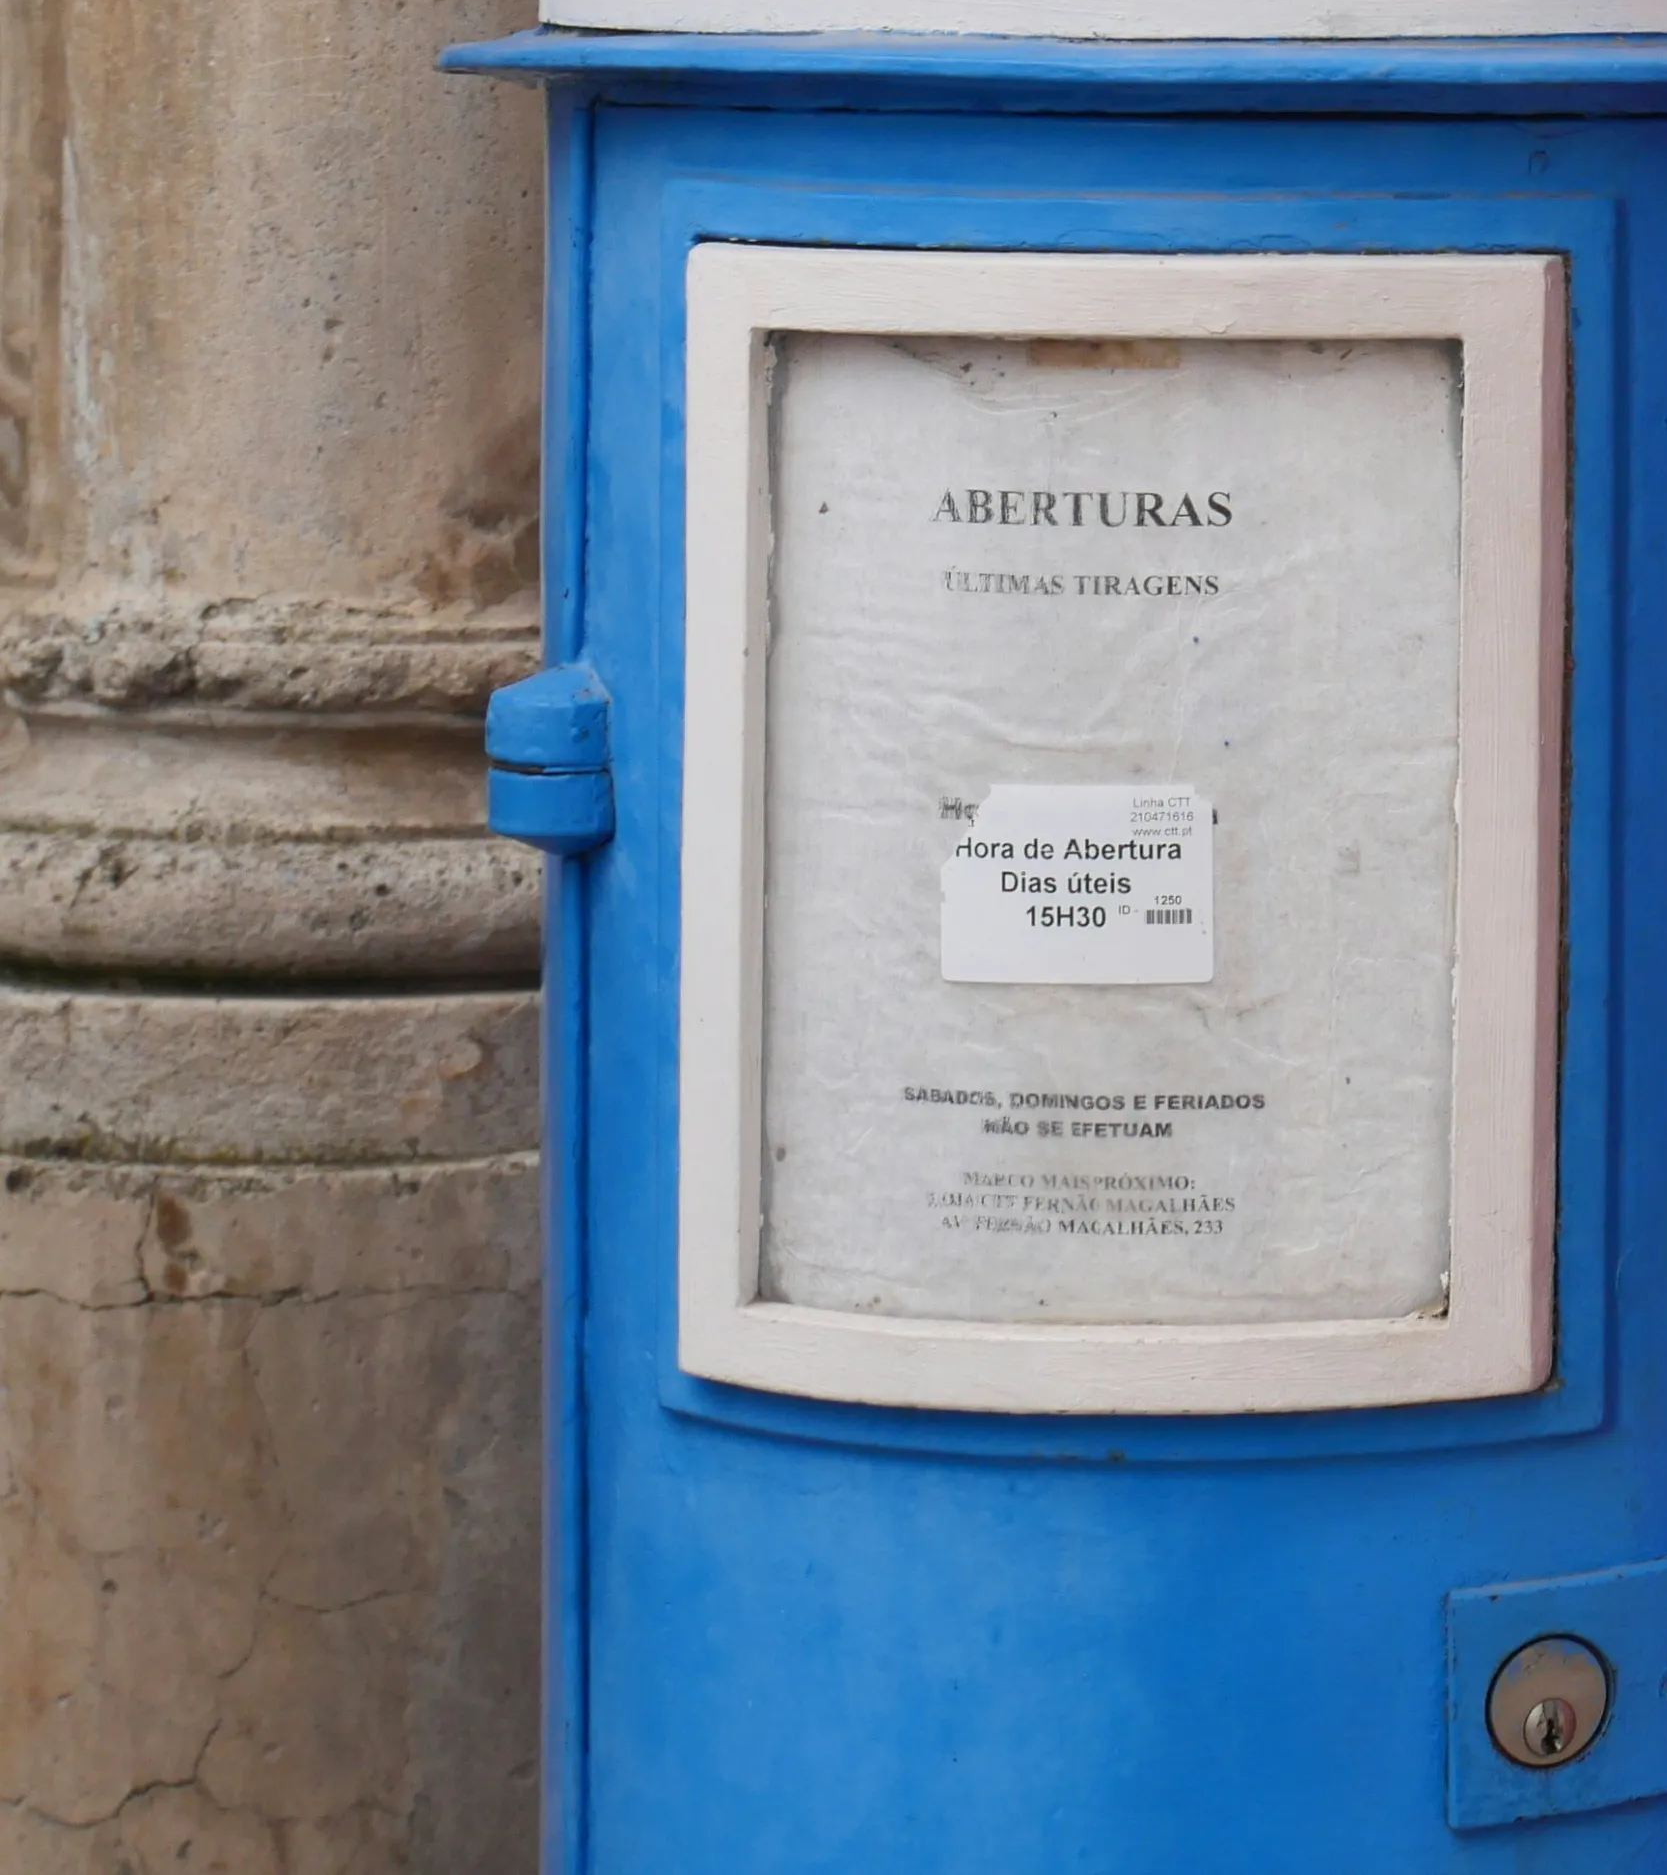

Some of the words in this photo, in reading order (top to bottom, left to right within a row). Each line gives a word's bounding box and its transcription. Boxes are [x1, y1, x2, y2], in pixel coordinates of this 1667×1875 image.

[932, 488, 1233, 527] ABERTURAS
[1074, 575, 1219, 596] TIRAGENS
[1132, 798, 1165, 809] Linha
[1167, 796, 1191, 808] CTT
[1130, 810, 1194, 823] 210471616
[1023, 837, 1055, 861] de
[1063, 838, 1182, 861] Abertura
[1001, 871, 1057, 894] Dias
[1067, 871, 1132, 895] úteis
[1154, 894, 1182, 906] 1250
[1026, 905, 1107, 928] 15H30
[1118, 904, 1131, 915] ID
[1009, 1092, 1126, 1111] DOMINGOS
[1133, 1094, 1147, 1111] E
[1154, 1094, 1266, 1110] FERIADOS
[1037, 1120, 1063, 1138] SE
[1071, 1121, 1173, 1138] EFETUAM
[1106, 1194, 1236, 1214] MAGALHÃES
[1194, 1219, 1223, 1235] 233
